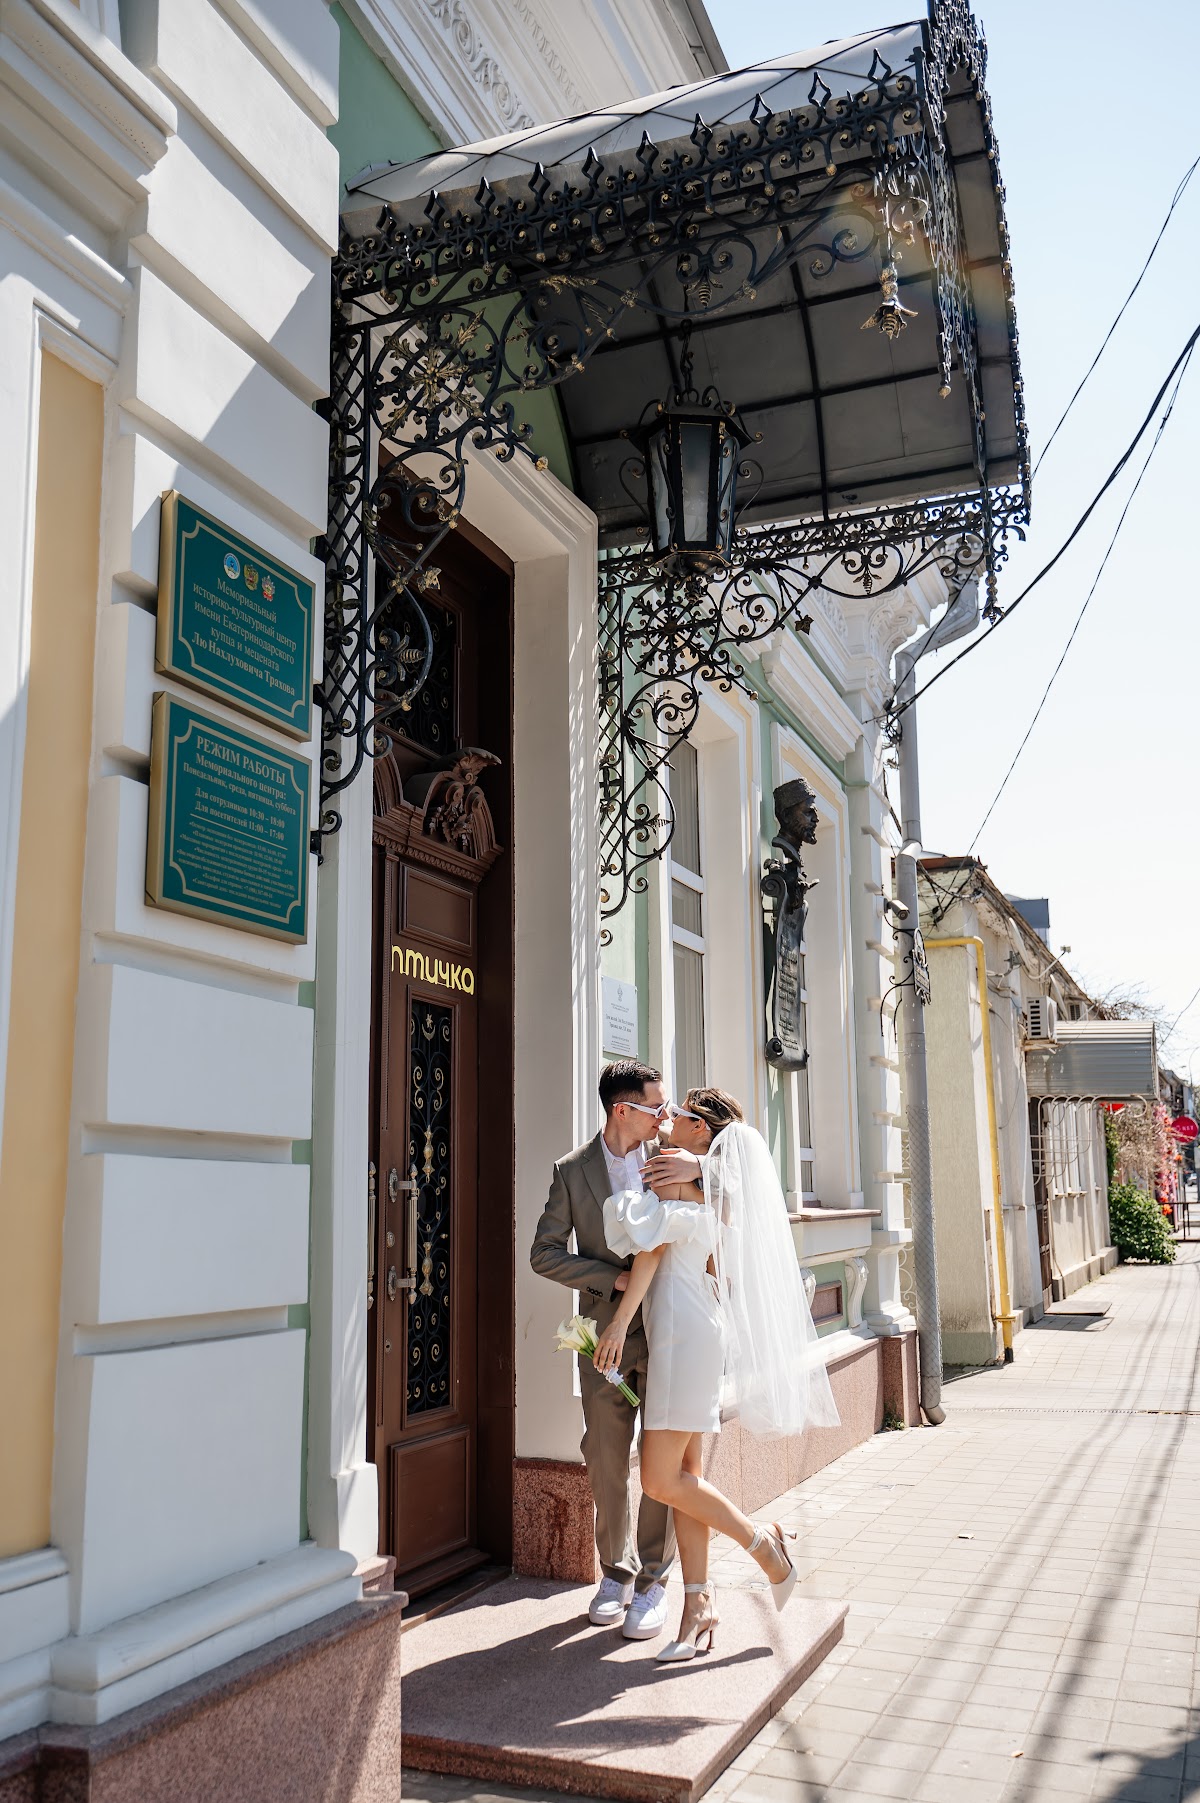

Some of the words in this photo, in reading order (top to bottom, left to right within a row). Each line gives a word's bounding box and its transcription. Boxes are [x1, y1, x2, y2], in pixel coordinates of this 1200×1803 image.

[193, 583, 275, 641] историко-культурный
[276, 631, 297, 652] центр
[217, 577, 277, 624] Мемориальный
[194, 601, 221, 623] имени
[223, 614, 295, 665] Екатеринодарского
[210, 626, 235, 648] купца
[244, 645, 280, 672] мецената
[192, 631, 207, 650] Лю
[208, 639, 263, 679] Нахлуховича
[265, 669, 295, 697] Трахова
[196, 735, 240, 767] РЕЖИМ
[242, 755, 286, 786] РАБОТЫ
[196, 752, 258, 789] Мемориального
[259, 782, 287, 800] центра:
[194, 786, 209, 800] Для
[194, 800, 209, 814] Для
